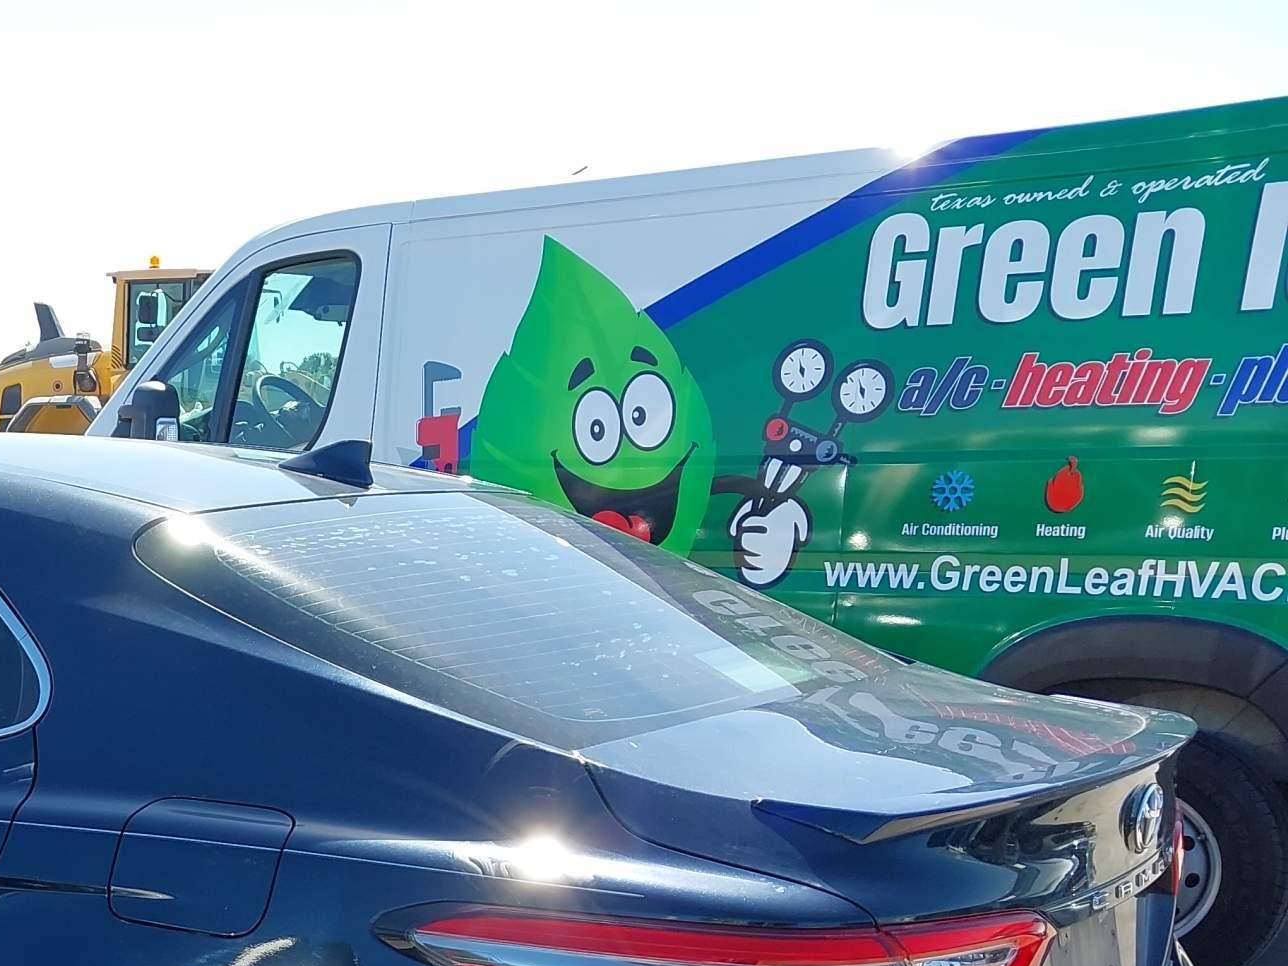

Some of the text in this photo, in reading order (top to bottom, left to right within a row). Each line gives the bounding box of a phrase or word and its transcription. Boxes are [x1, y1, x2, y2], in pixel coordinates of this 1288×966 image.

[930, 158, 1270, 212] texas owned & operated
[862, 206, 1207, 330] Green
[897, 343, 1288, 417] a/c heating pl
[901, 523, 999, 539] Air Conditioning
[1036, 523, 1086, 540] Heating
[1145, 525, 1215, 542] Air Quality
[823, 555, 1288, 602] www.GreenLeafHVAC
